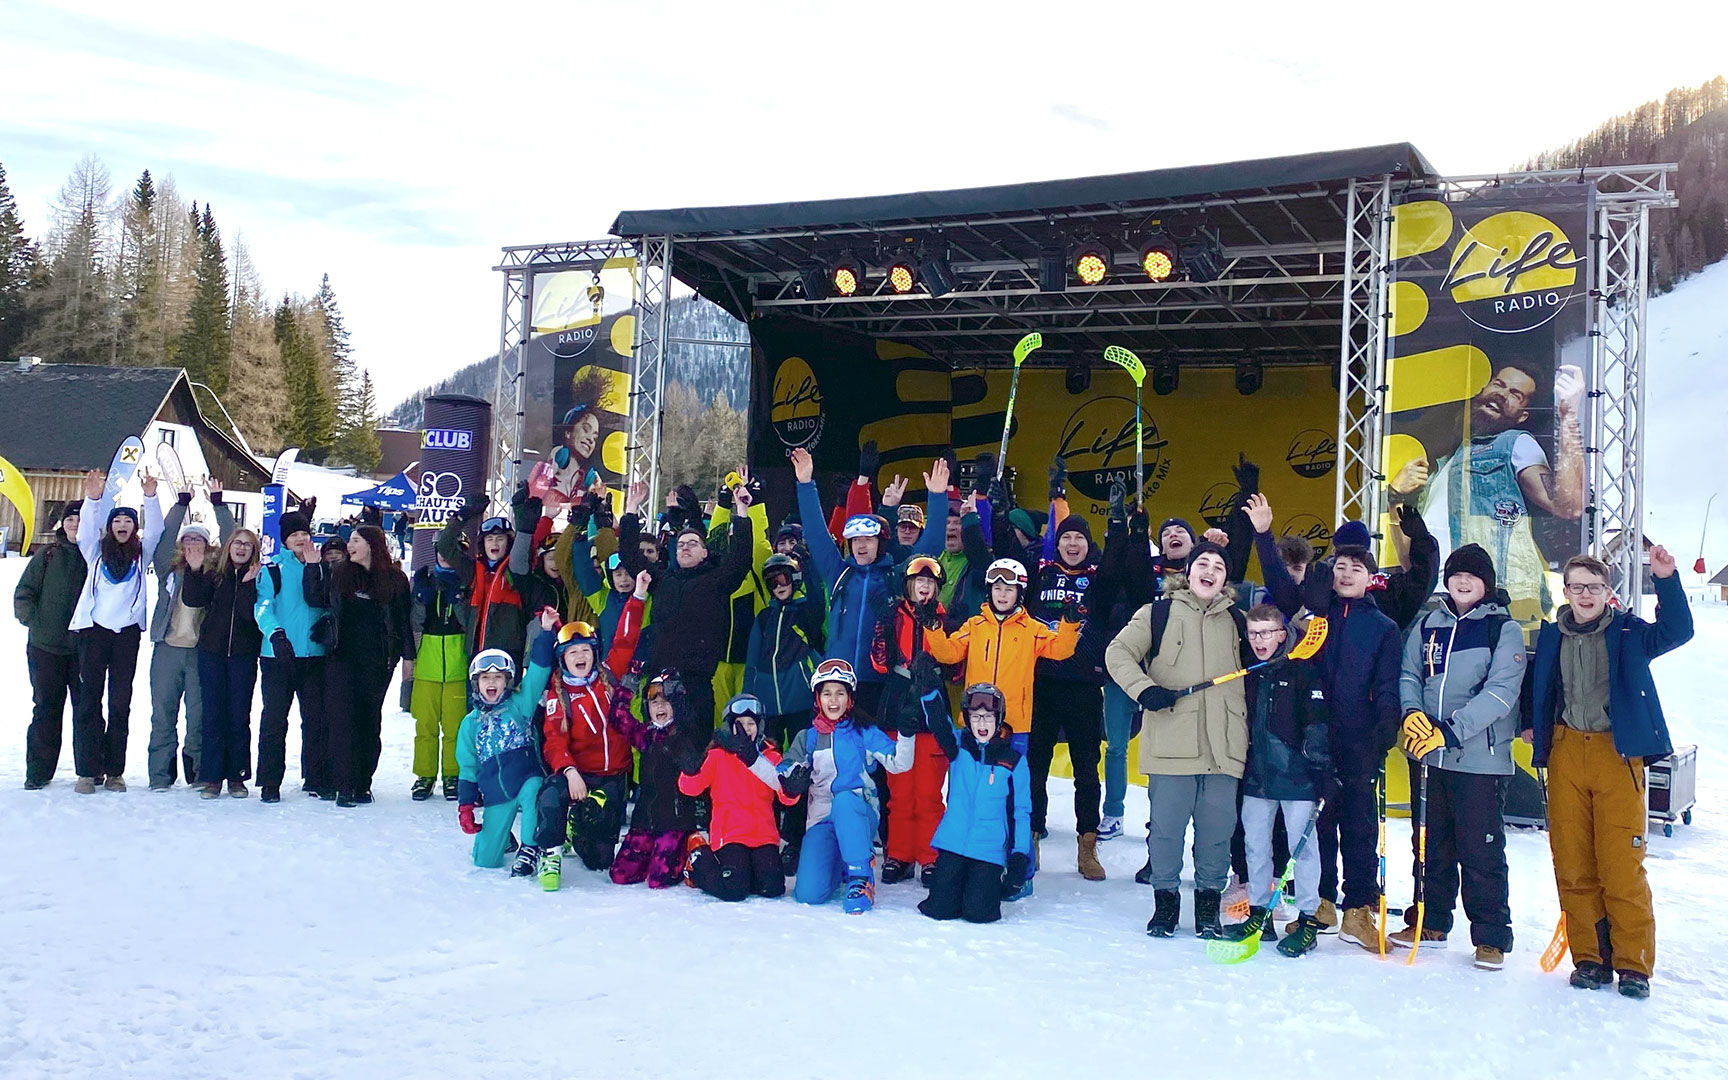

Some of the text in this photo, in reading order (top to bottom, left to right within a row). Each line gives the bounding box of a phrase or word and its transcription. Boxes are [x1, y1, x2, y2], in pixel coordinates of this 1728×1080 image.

[1440, 230, 1587, 294] Life
[533, 285, 594, 329] Lif
[1494, 291, 1560, 314] RADIO
[558, 328, 593, 344] RADIO
[771, 375, 825, 417] Life
[787, 418, 815, 432] RADIO
[425, 430, 470, 449] CLUB
[1056, 415, 1169, 468] Life
[1285, 438, 1338, 463] Life
[1158, 458, 1171, 481] Mix
[1305, 462, 1331, 472] RADIO
[377, 485, 405, 496] Tips
[421, 471, 462, 498] SO
[417, 498, 464, 508] HAUT'S
[1198, 491, 1240, 516] Lif
[1040, 589, 1084, 603] UNIBET
